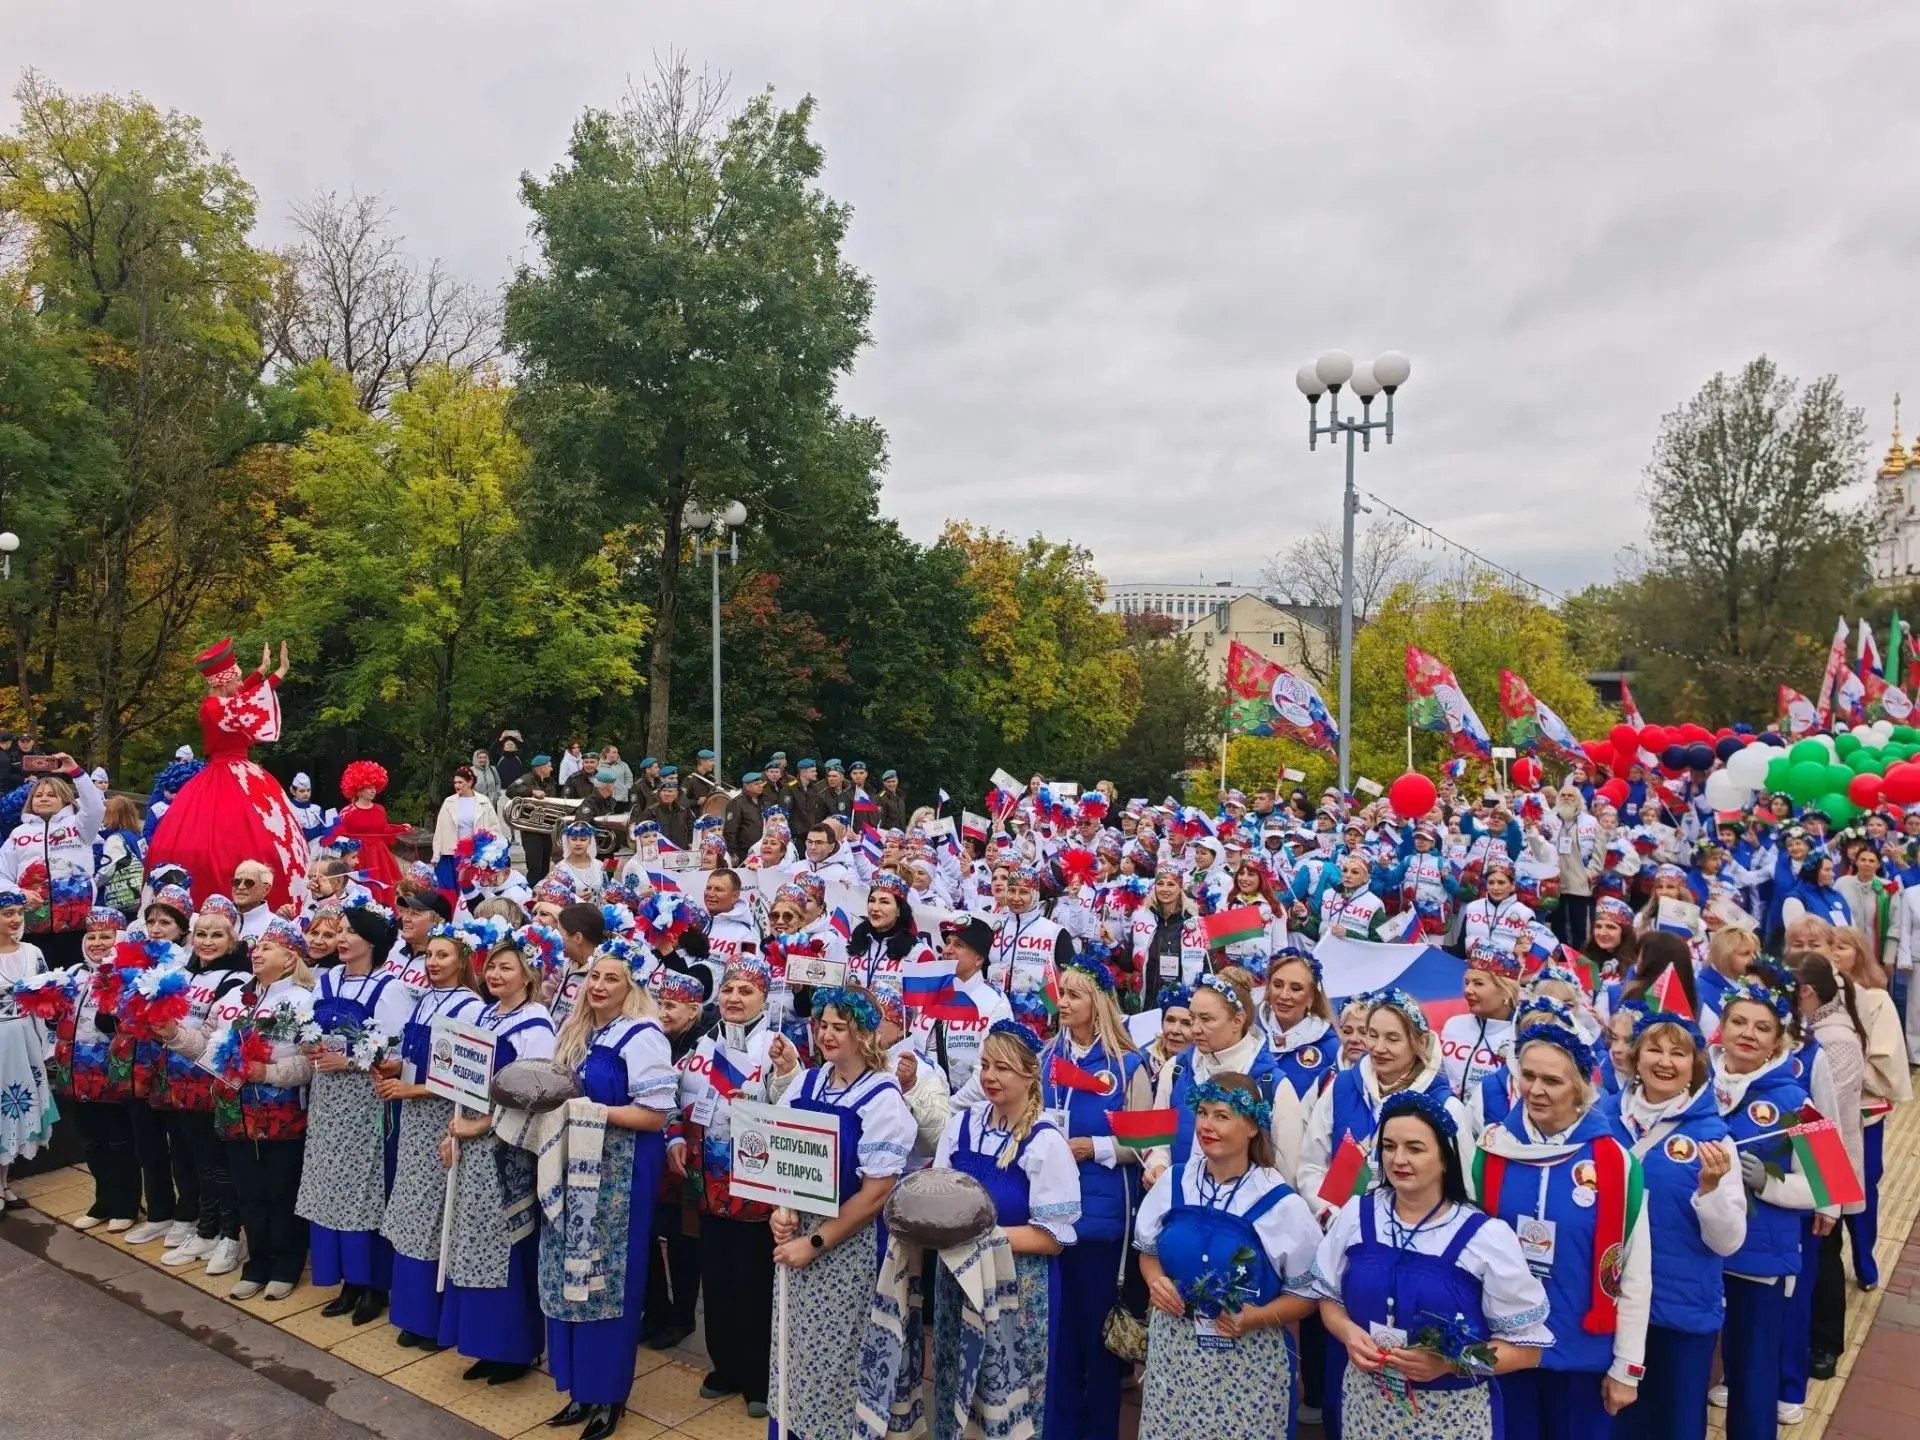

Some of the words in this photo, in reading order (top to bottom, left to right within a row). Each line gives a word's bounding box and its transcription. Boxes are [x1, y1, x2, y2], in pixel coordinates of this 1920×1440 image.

[454, 1044, 488, 1066] РОССИЙСКАЯ
[452, 1064, 485, 1086] ФЕДЕРАЦИЯ
[769, 1135, 829, 1159] РЕСПУБЛИКА
[776, 1161, 823, 1183] БЕЛАРУСЬ
